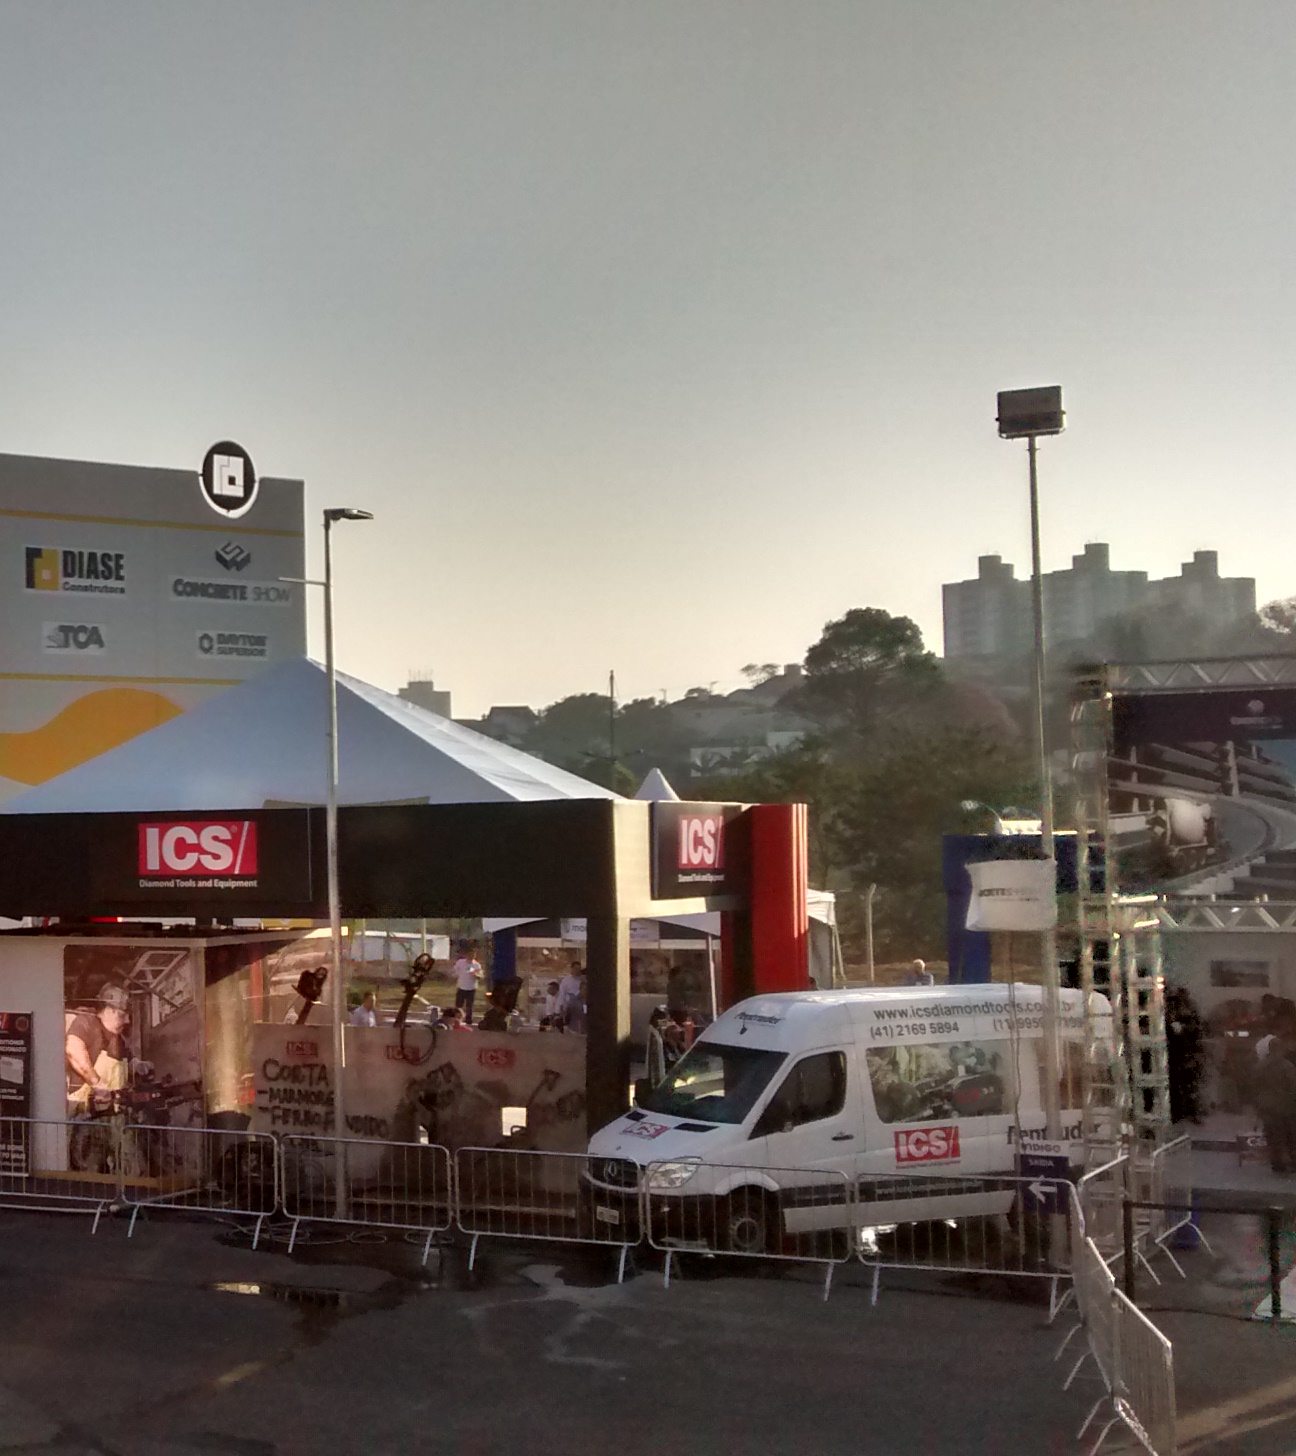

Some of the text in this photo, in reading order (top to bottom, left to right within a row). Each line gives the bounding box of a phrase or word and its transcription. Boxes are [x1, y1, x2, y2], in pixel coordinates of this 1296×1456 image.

[62, 550, 125, 581] DIASE
[173, 578, 291, 602] CONCRETE SHOW
[139, 879, 258, 890] Diamond Tools and Equipment
[870, 1021, 960, 1040] (41) 2169 5894
